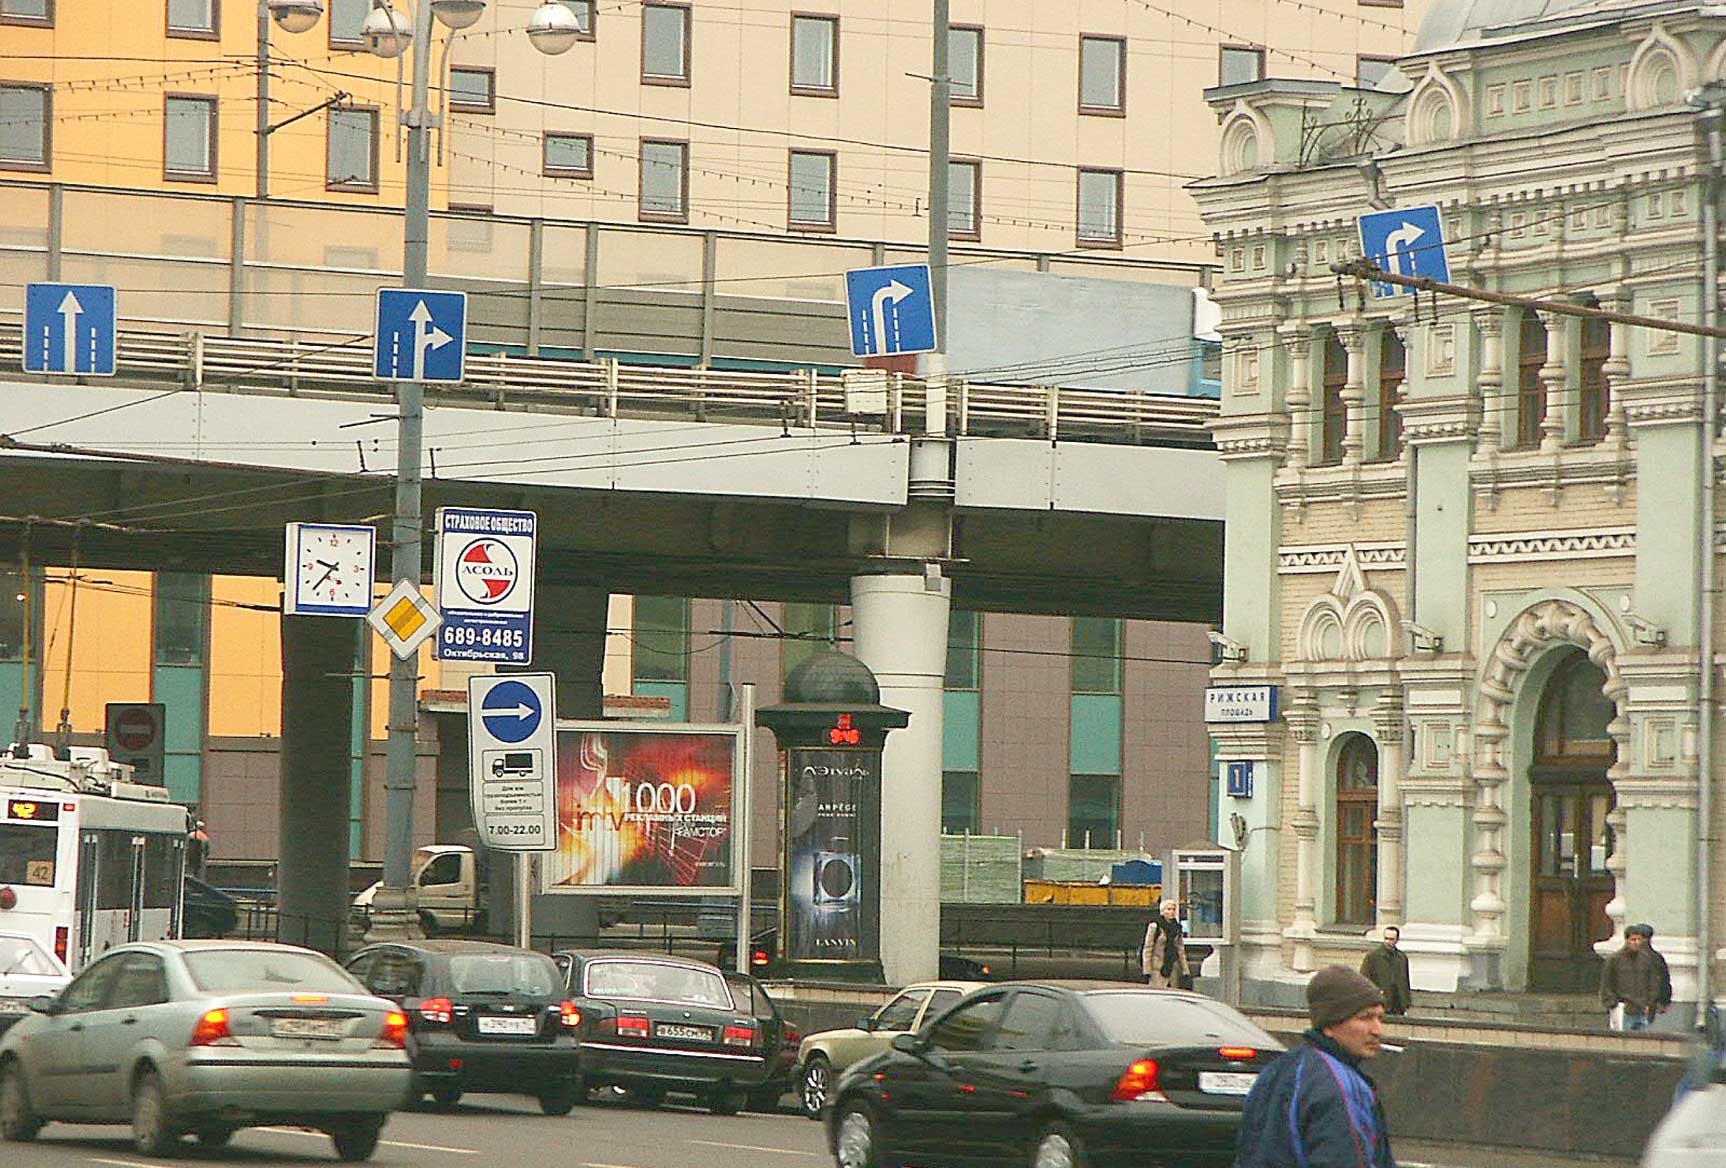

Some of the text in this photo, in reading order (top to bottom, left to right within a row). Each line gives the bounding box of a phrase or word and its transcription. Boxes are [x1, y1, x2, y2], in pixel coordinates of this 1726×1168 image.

[445, 513, 533, 534] СТРАХОВОЕ ОБЩЕСТВО
[444, 627, 523, 647] 689-8485
[1210, 692, 1265, 702] РИЖСКАЯ
[1234, 768, 1240, 788] 1
[623, 782, 696, 814] 1000
[488, 825, 541, 835] 7.00-22.00
[32, 866, 48, 880] 42
